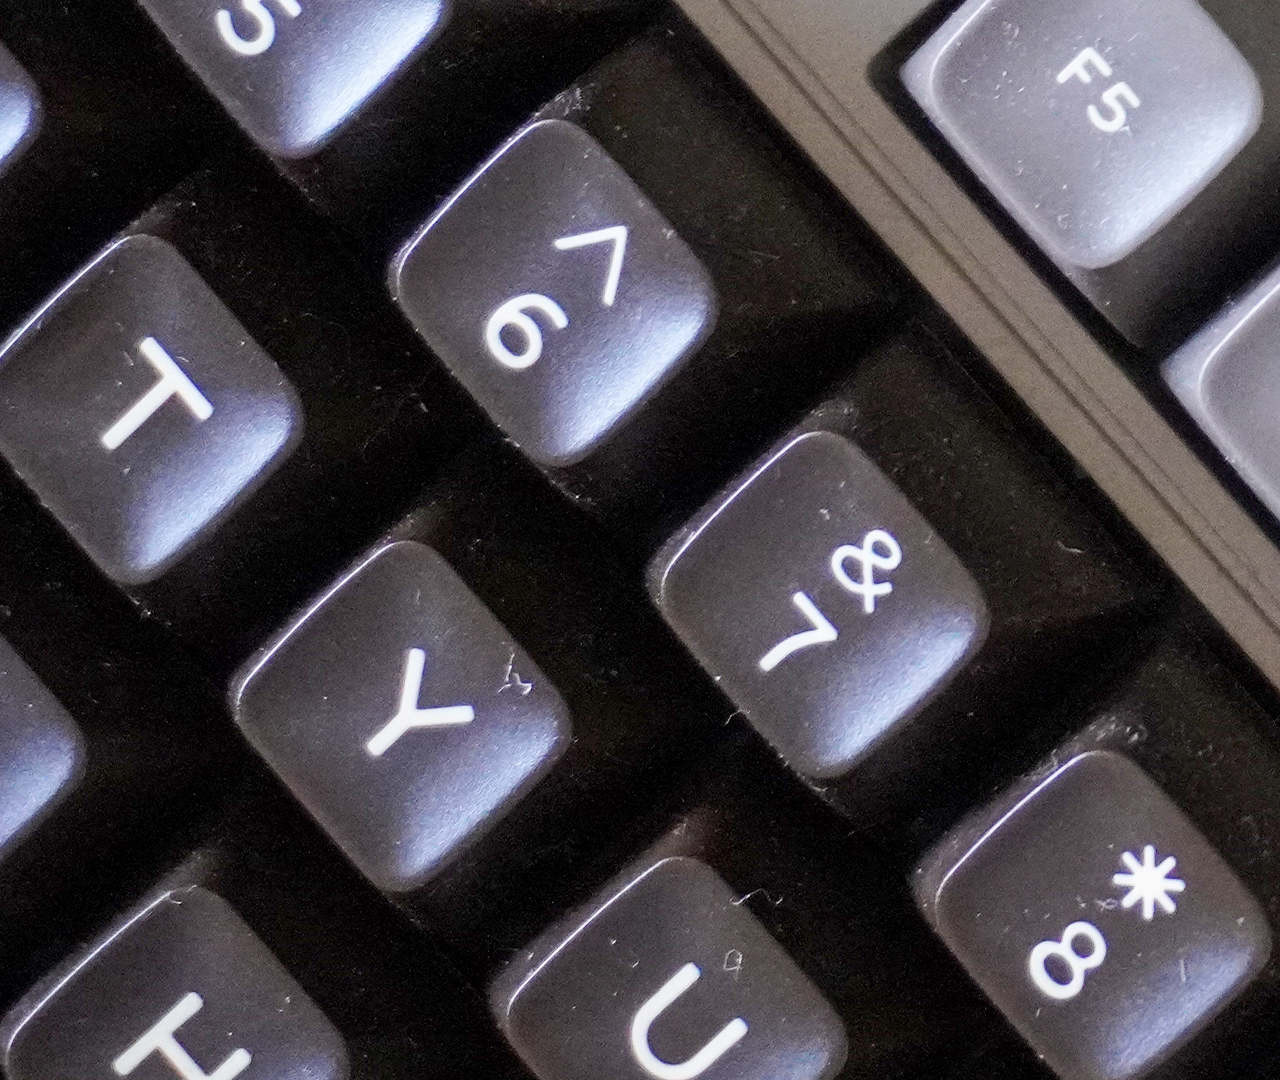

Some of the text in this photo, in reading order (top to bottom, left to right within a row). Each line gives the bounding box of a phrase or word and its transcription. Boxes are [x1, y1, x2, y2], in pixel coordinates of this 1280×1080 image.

[1056, 46, 1142, 133] F5
[485, 293, 569, 369] 6
[101, 336, 214, 451] T
[830, 528, 902, 614] &
[758, 591, 839, 674] 7
[365, 647, 475, 757] Y
[1028, 920, 1107, 1000] 8
[631, 961, 749, 1080] U
